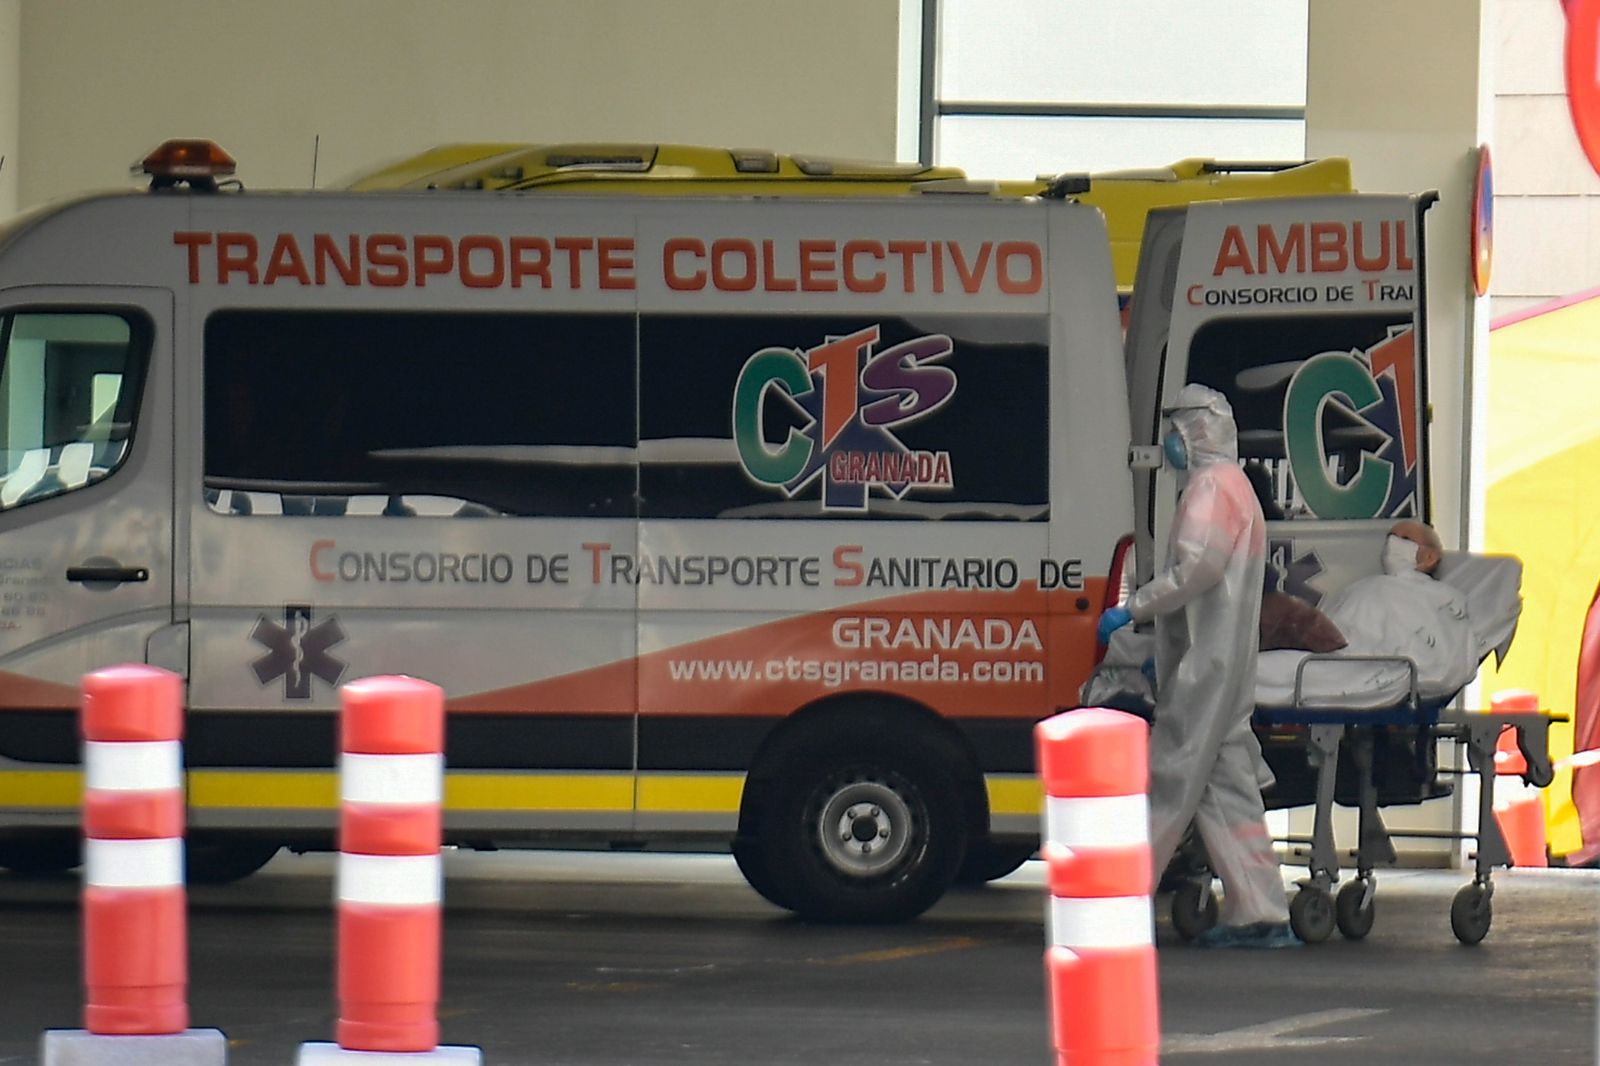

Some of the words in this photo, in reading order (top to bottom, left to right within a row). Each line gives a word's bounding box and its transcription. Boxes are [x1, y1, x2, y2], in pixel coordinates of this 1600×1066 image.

[174, 231, 637, 290] TRANSPORTE
[663, 237, 1042, 294] COLECTIVO
[1213, 220, 1413, 276] AMBUL
[1187, 284, 1318, 306] CONSORCIO
[1326, 286, 1354, 301] DE
[1362, 279, 1413, 302] TRA
[733, 324, 958, 486] CTS
[830, 451, 950, 484] GRANADA
[309, 539, 514, 584] CONSORCIO
[527, 553, 569, 584] DE
[581, 542, 820, 587] TRANSPORTE
[832, 544, 1019, 589] SANITARIO
[1039, 558, 1083, 589] DE
[832, 618, 1042, 651] GRANADA
[669, 655, 1044, 687] www.ctsgranada.com
